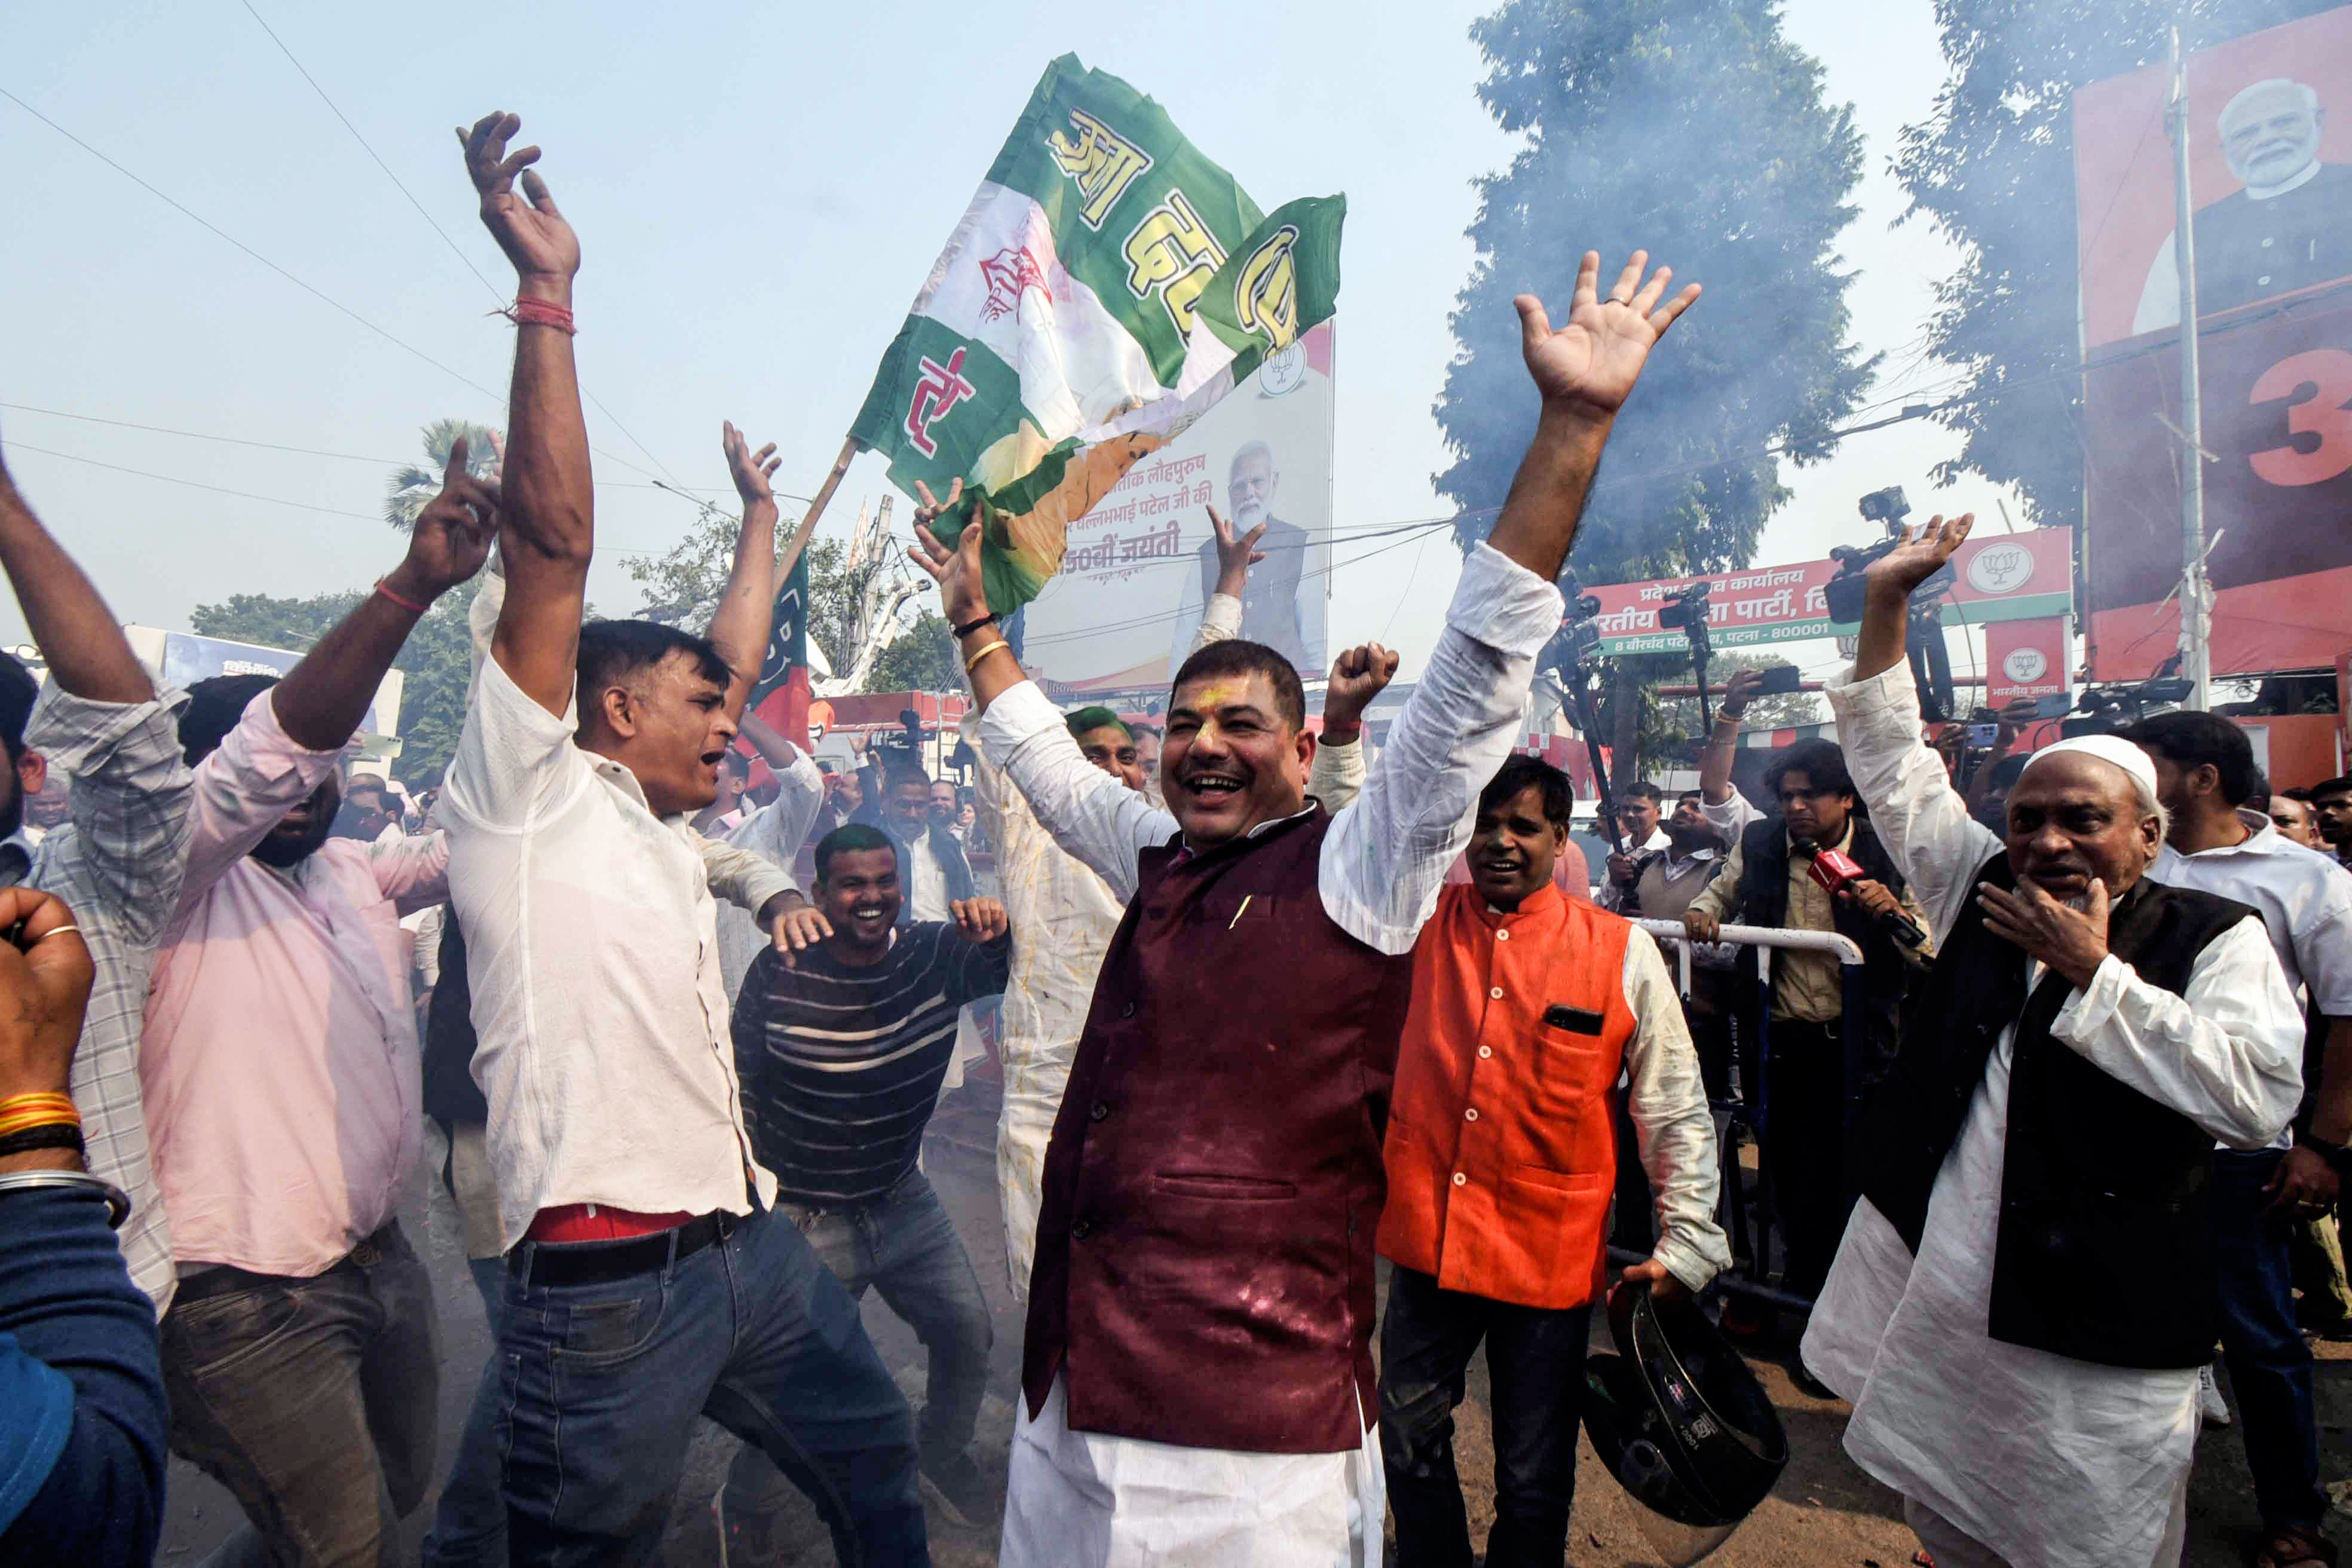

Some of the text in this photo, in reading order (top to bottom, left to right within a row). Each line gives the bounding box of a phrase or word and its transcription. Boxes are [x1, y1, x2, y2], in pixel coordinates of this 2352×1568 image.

[2248, 348, 2352, 487] 3
[1147, 454, 1206, 485] लौहपुरुष
[1139, 494, 1170, 516] पटेल
[1172, 485, 1190, 509] जी
[1193, 480, 1213, 504] की
[1119, 519, 1181, 563] जयंती
[1730, 569, 1805, 591] कार्यालय
[1734, 588, 1797, 618] पार्टी,
[1726, 630, 1760, 642] पटना
[1771, 623, 1829, 639] 800001
